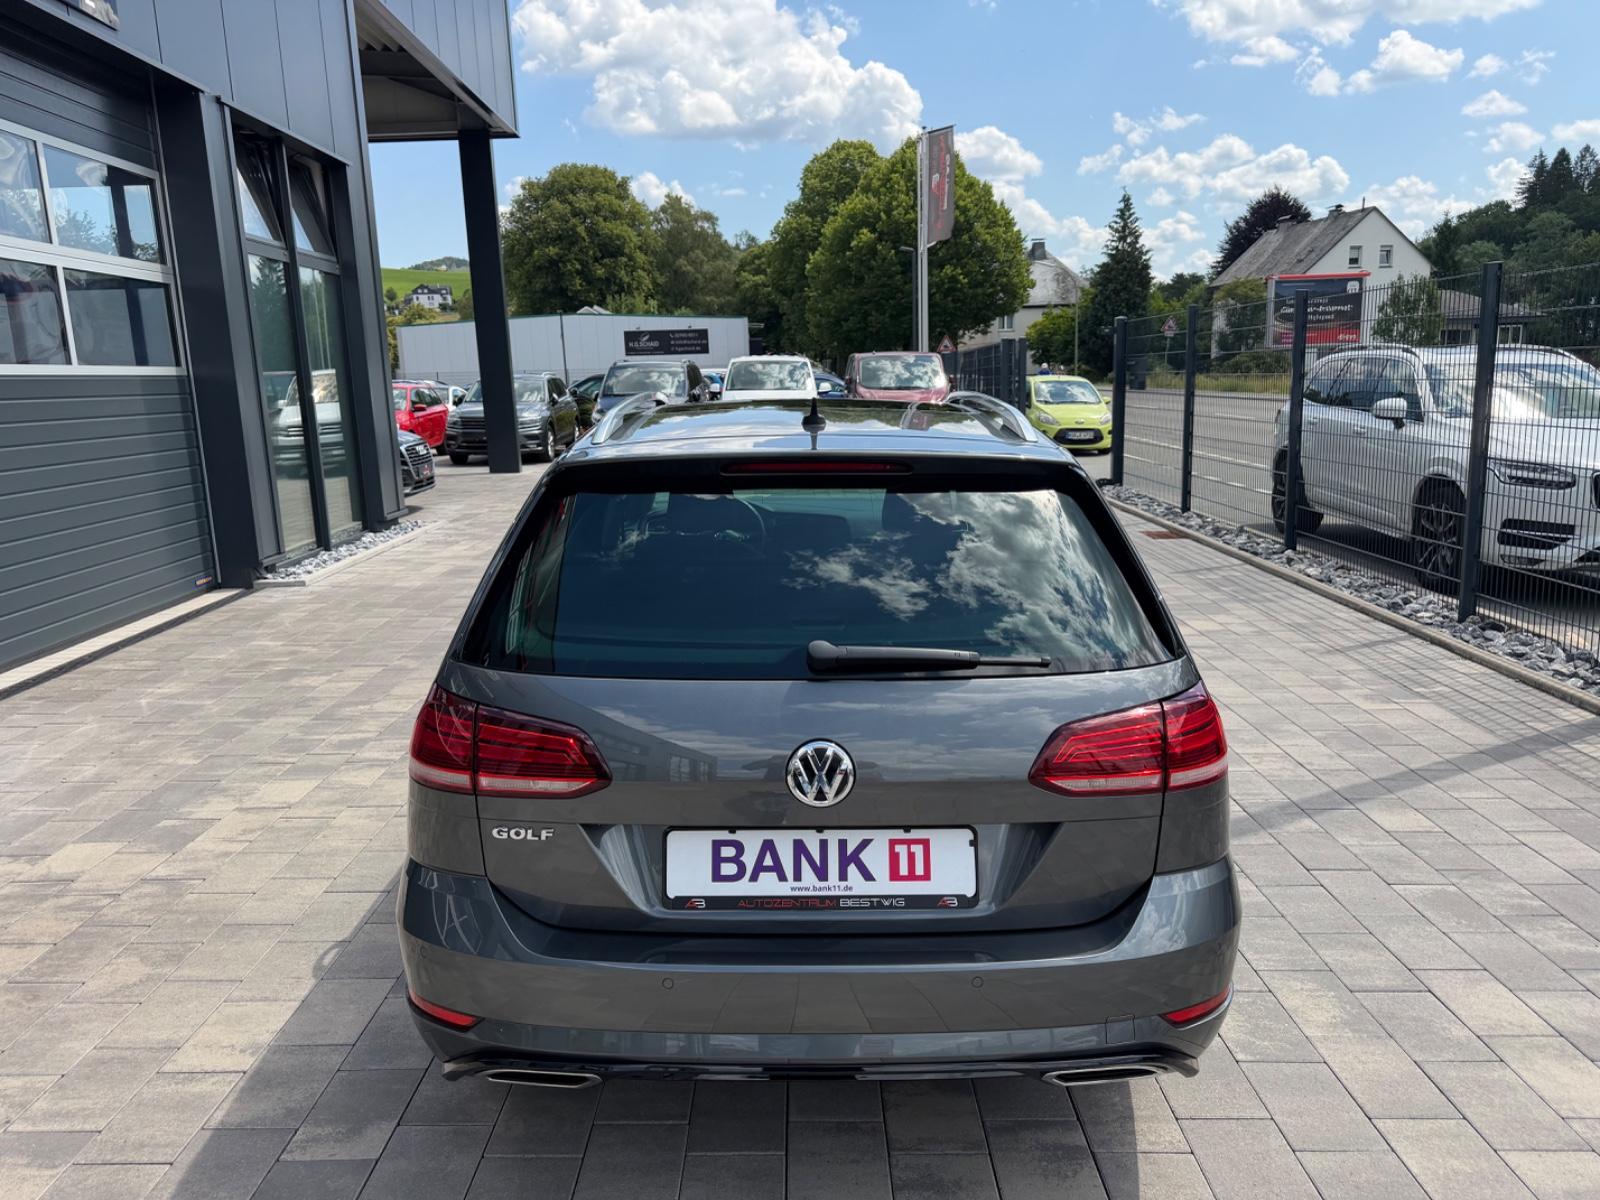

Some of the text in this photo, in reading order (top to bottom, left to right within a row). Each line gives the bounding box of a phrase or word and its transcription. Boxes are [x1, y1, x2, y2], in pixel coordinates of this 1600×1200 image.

[492, 827, 554, 840] GOLF
[711, 838, 926, 882] BANK 11
[790, 884, 853, 893] www.bank11.de
[738, 898, 905, 908] AUTOZENTRUM BESTWIG
